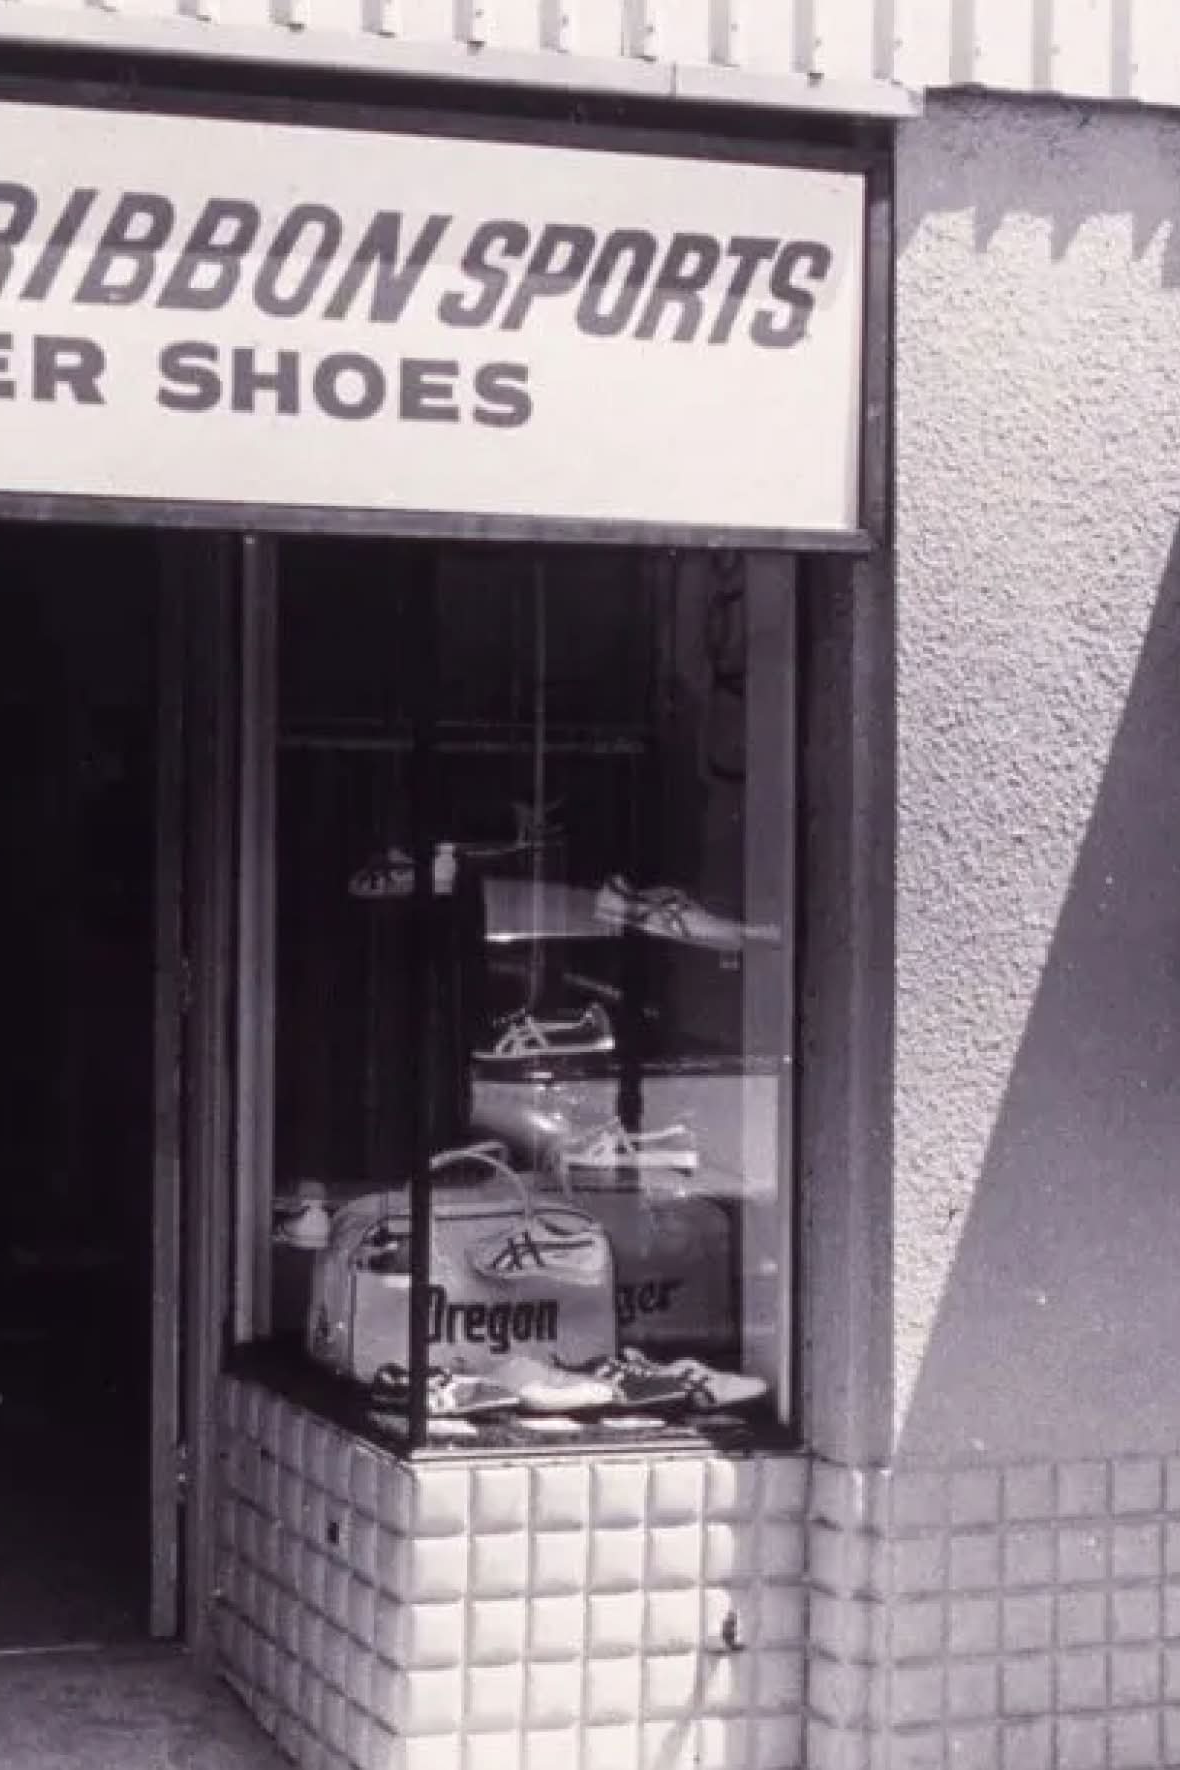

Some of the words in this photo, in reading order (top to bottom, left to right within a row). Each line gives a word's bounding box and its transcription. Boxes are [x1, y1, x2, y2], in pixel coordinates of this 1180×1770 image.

[437, 220, 833, 349] SPORTS
[157, 340, 533, 429] SHOES
[425, 1284, 558, 1354] Oregon
[618, 1278, 683, 1326] ger
